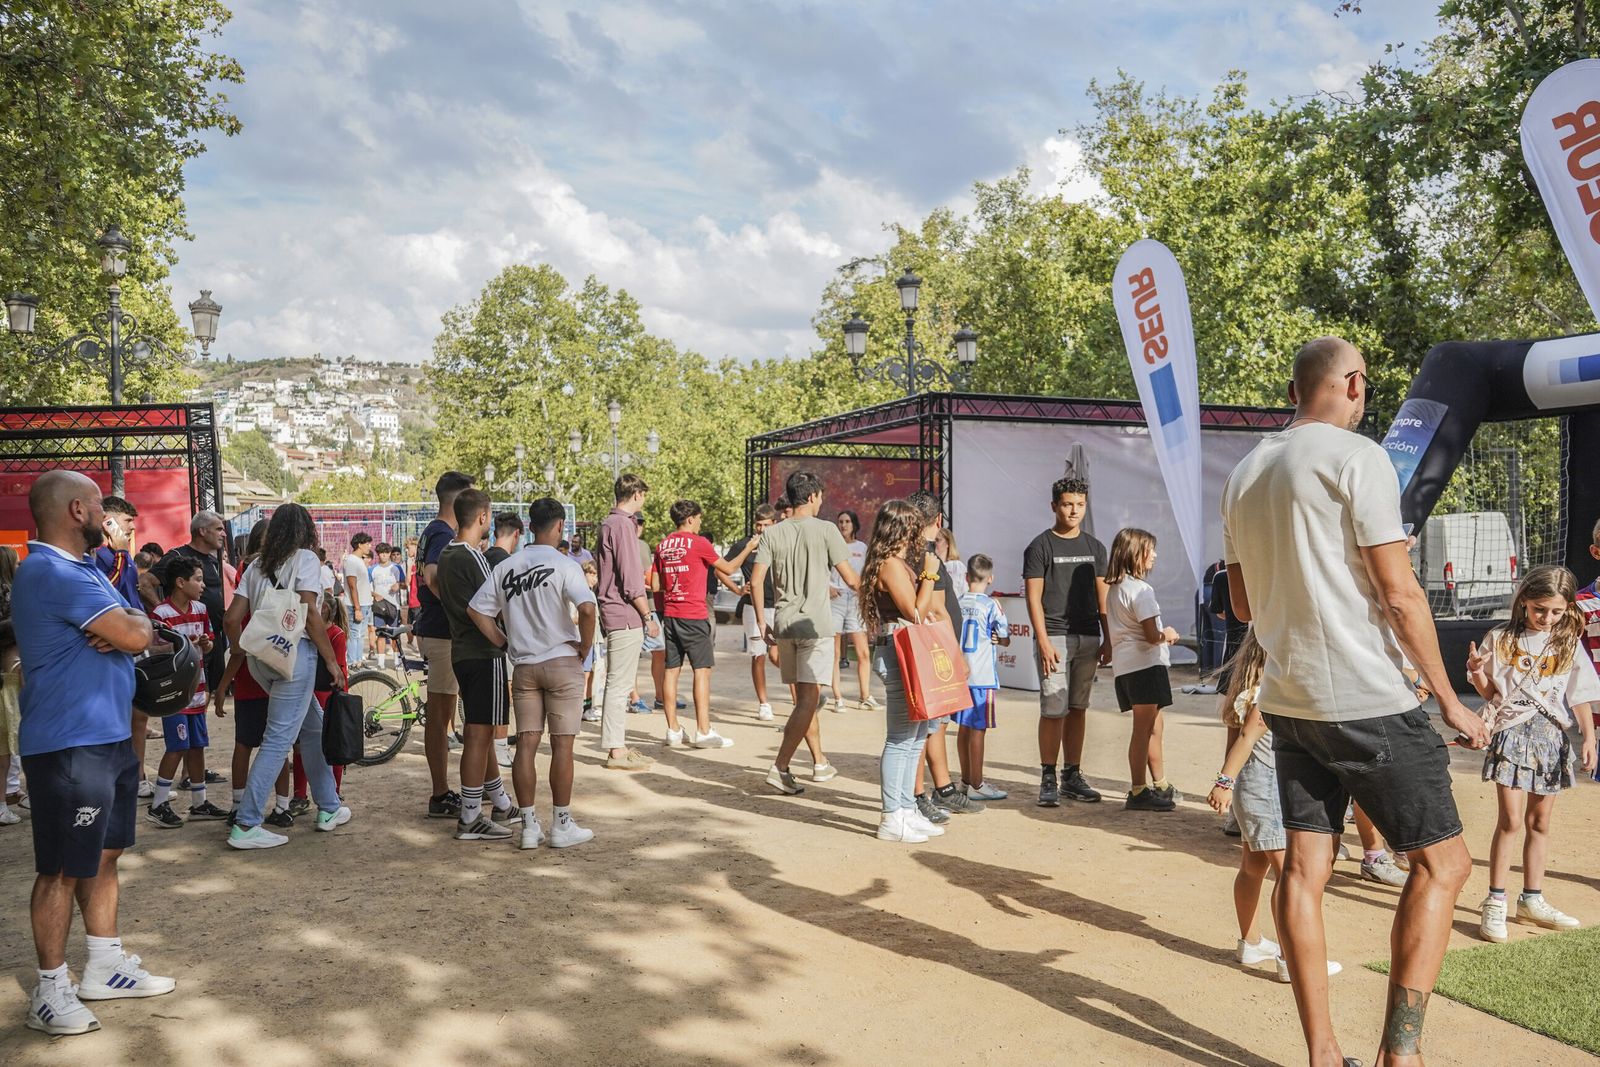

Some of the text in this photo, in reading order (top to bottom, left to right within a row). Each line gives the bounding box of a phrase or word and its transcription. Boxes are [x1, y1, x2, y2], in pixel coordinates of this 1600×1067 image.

[1396, 418, 1422, 427] mpre
[961, 619, 979, 653] 0
[1008, 623, 1030, 637] SEUR
[266, 634, 294, 653] APK
